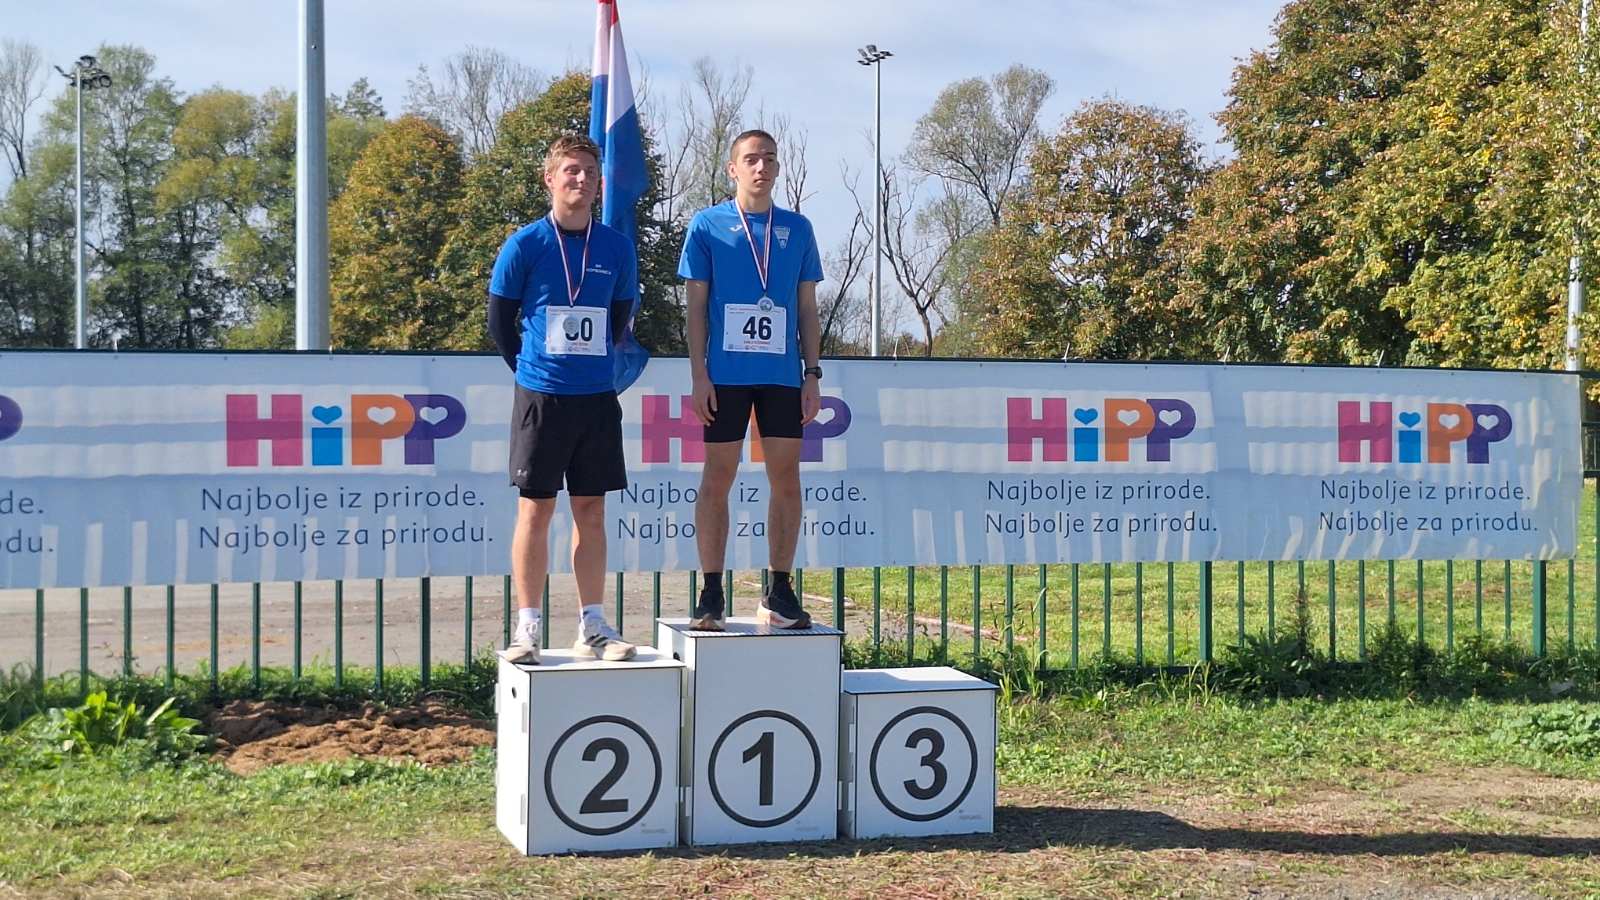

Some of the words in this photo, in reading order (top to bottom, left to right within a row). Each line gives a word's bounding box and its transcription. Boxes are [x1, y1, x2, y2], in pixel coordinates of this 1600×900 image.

[742, 315, 772, 341] 46
[226, 394, 467, 467] HiPP
[641, 395, 852, 463] HP
[1006, 397, 1197, 463] HiPP
[1337, 401, 1513, 464] HiPP
[202, 486, 328, 517] Najbolje
[339, 486, 362, 508] iz
[374, 483, 485, 514] prirode.
[739, 482, 760, 503] iz
[987, 479, 1087, 506] Najbolje
[1095, 480, 1113, 500] iz
[1122, 479, 1211, 505] prirode.
[1321, 479, 1411, 505] Najbolje
[1418, 481, 1437, 500] iz
[1445, 481, 1531, 505] prirode.
[200, 523, 326, 554] Najbolje
[336, 529, 369, 545] za
[382, 520, 493, 551] prirodu.
[737, 521, 766, 537] za
[986, 511, 1085, 539] Najbolje
[1093, 518, 1119, 533] za
[1128, 511, 1217, 537] prirodu.
[1319, 511, 1408, 536] Najbolje
[1416, 517, 1442, 531] za
[1452, 511, 1538, 535] prirodu.
[579, 737, 630, 815] 2
[742, 731, 774, 806] 1
[903, 727, 948, 800] 3
